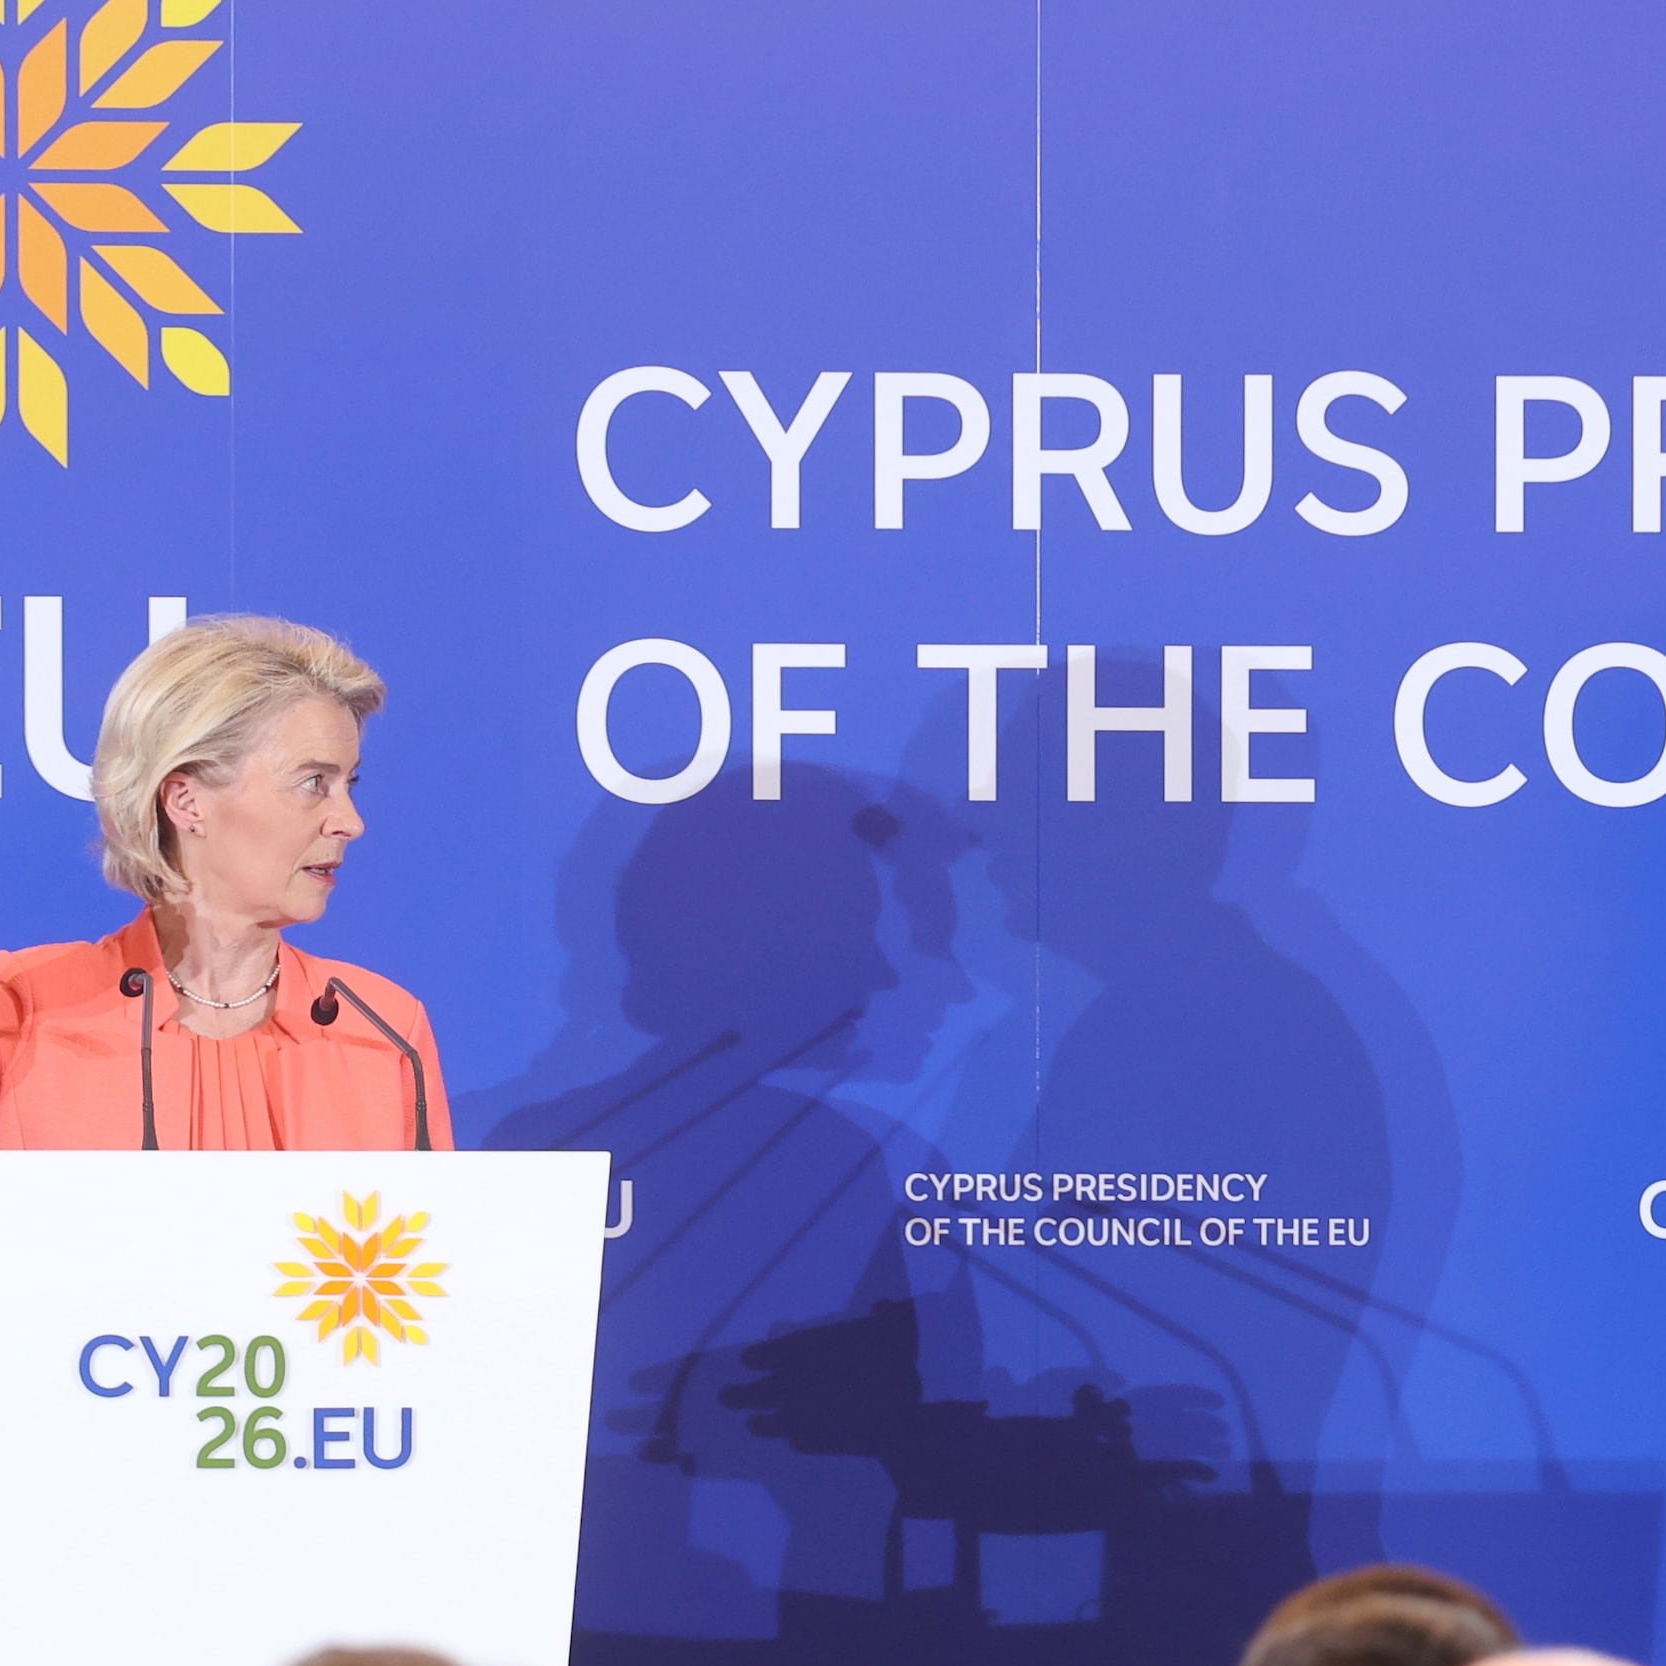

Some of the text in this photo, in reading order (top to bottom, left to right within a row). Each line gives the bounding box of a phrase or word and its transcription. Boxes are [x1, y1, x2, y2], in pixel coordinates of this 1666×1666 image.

[575, 365, 1410, 536] CYPRUS
[575, 637, 847, 805] OF
[916, 643, 1317, 803] THE
[904, 1172, 1269, 1202] CYPRUS PRESIDENCY
[904, 1217, 1371, 1247] OF THE COUNCIL OF THE EU
[78, 1334, 286, 1398] CY20
[195, 1405, 412, 1470] 26.EU
